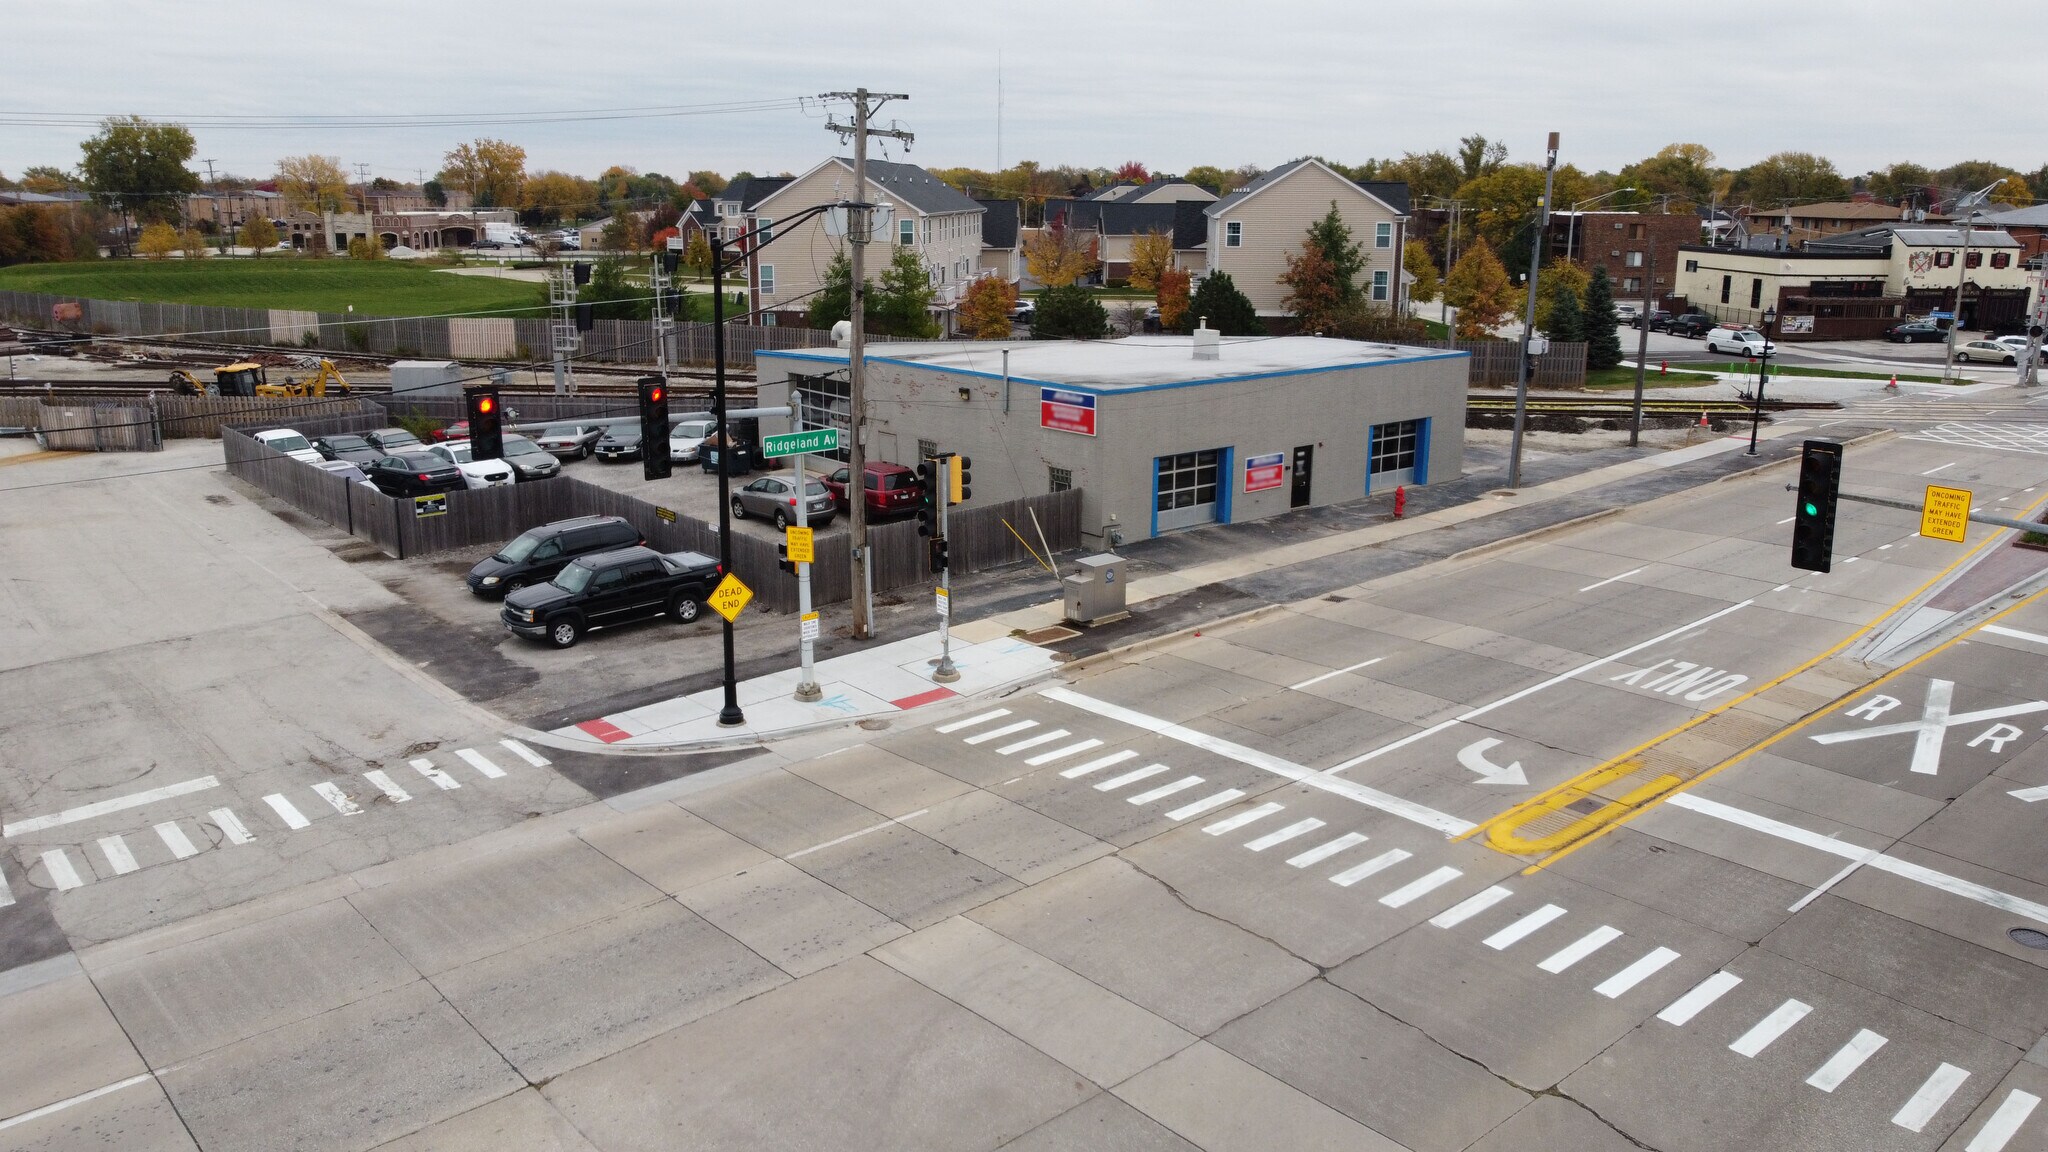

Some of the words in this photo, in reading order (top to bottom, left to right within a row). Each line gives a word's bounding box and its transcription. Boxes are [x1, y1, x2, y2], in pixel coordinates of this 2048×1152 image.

[766, 436, 819, 453] Ridgeland
[823, 434, 836, 446] Av
[1931, 491, 1966, 502] ONCOMING
[1934, 500, 1961, 510] TRAFFIC
[1945, 511, 1962, 520] HAVE
[1928, 517, 1961, 528] EXTENDED
[1932, 527, 1954, 536] GREEN
[718, 587, 743, 599] DEAD
[722, 599, 740, 610] END
